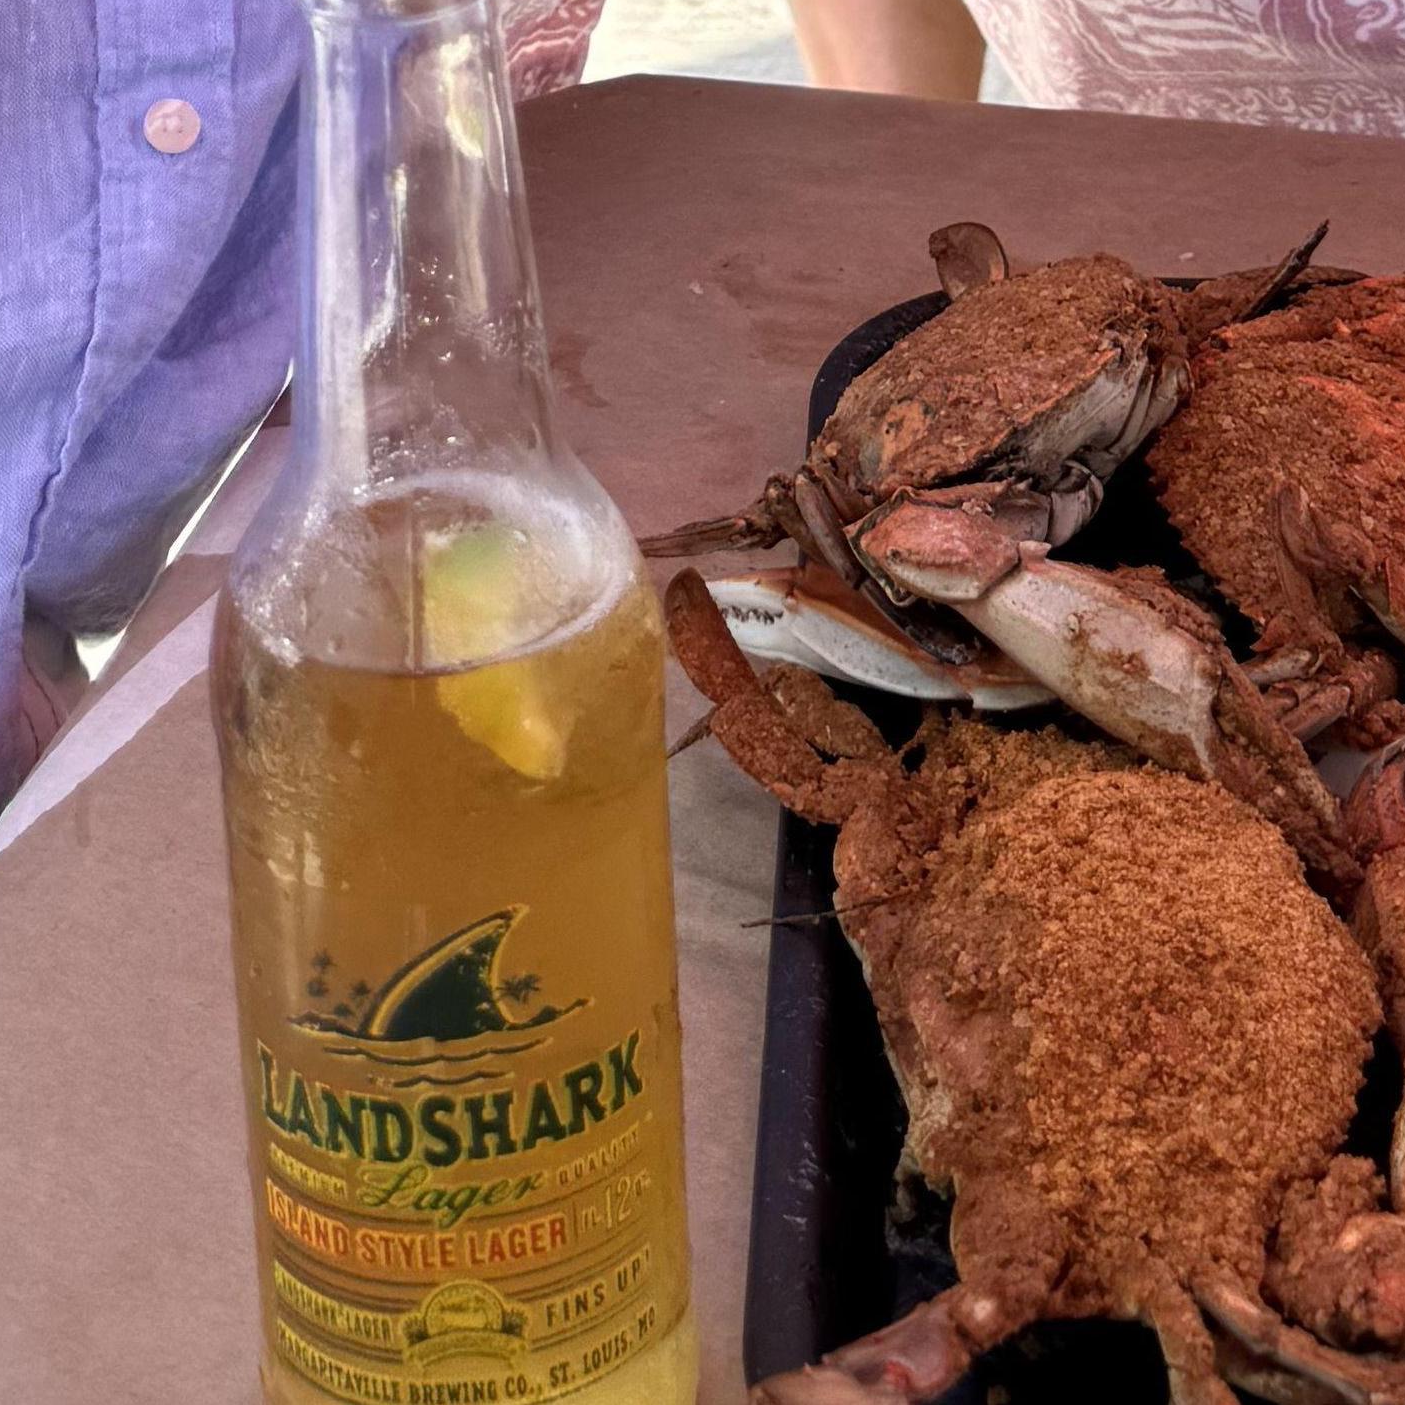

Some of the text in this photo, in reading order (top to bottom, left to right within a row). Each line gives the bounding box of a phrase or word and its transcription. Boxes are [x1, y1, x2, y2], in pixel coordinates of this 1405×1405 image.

[259, 1028, 644, 1169] LANDSHARK
[266, 1178, 351, 1259] ISLAND
[357, 1227, 456, 1270] STYLE
[467, 1213, 567, 1267] LAGER
[357, 1164, 544, 1229] Lager
[545, 1281, 606, 1329] FINS
[408, 1378, 498, 1405] BREWING
[549, 1360, 576, 1389] ST.
